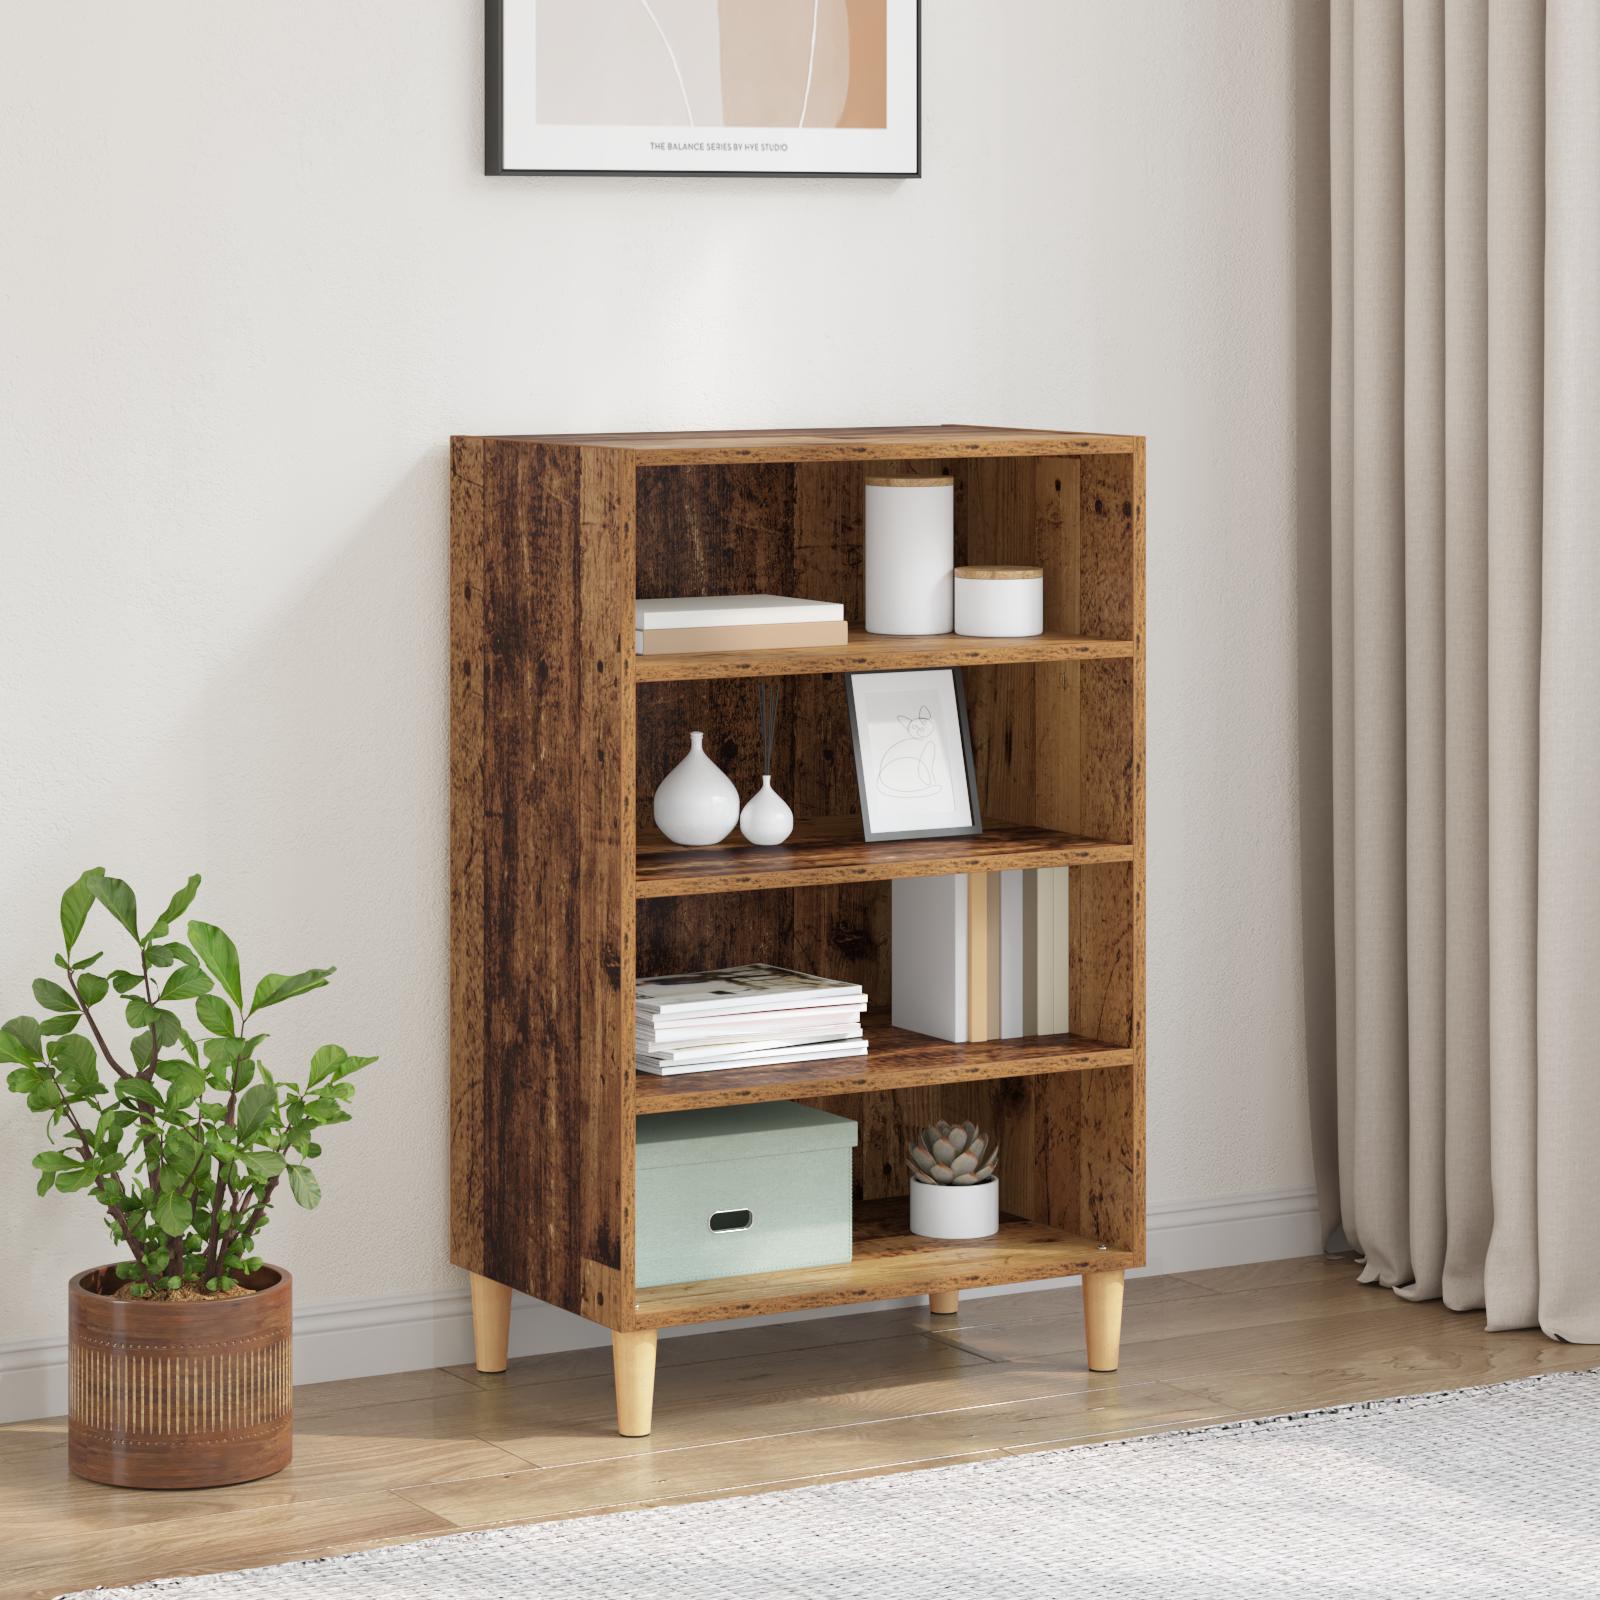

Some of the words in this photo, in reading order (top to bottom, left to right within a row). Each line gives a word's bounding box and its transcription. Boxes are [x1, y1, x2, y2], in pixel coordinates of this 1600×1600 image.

[650, 142, 665, 151] THE
[667, 142, 704, 151] BALANCE
[706, 142, 732, 151] SERIES
[733, 142, 742, 151] BY
[760, 143, 788, 152] STUDIO
